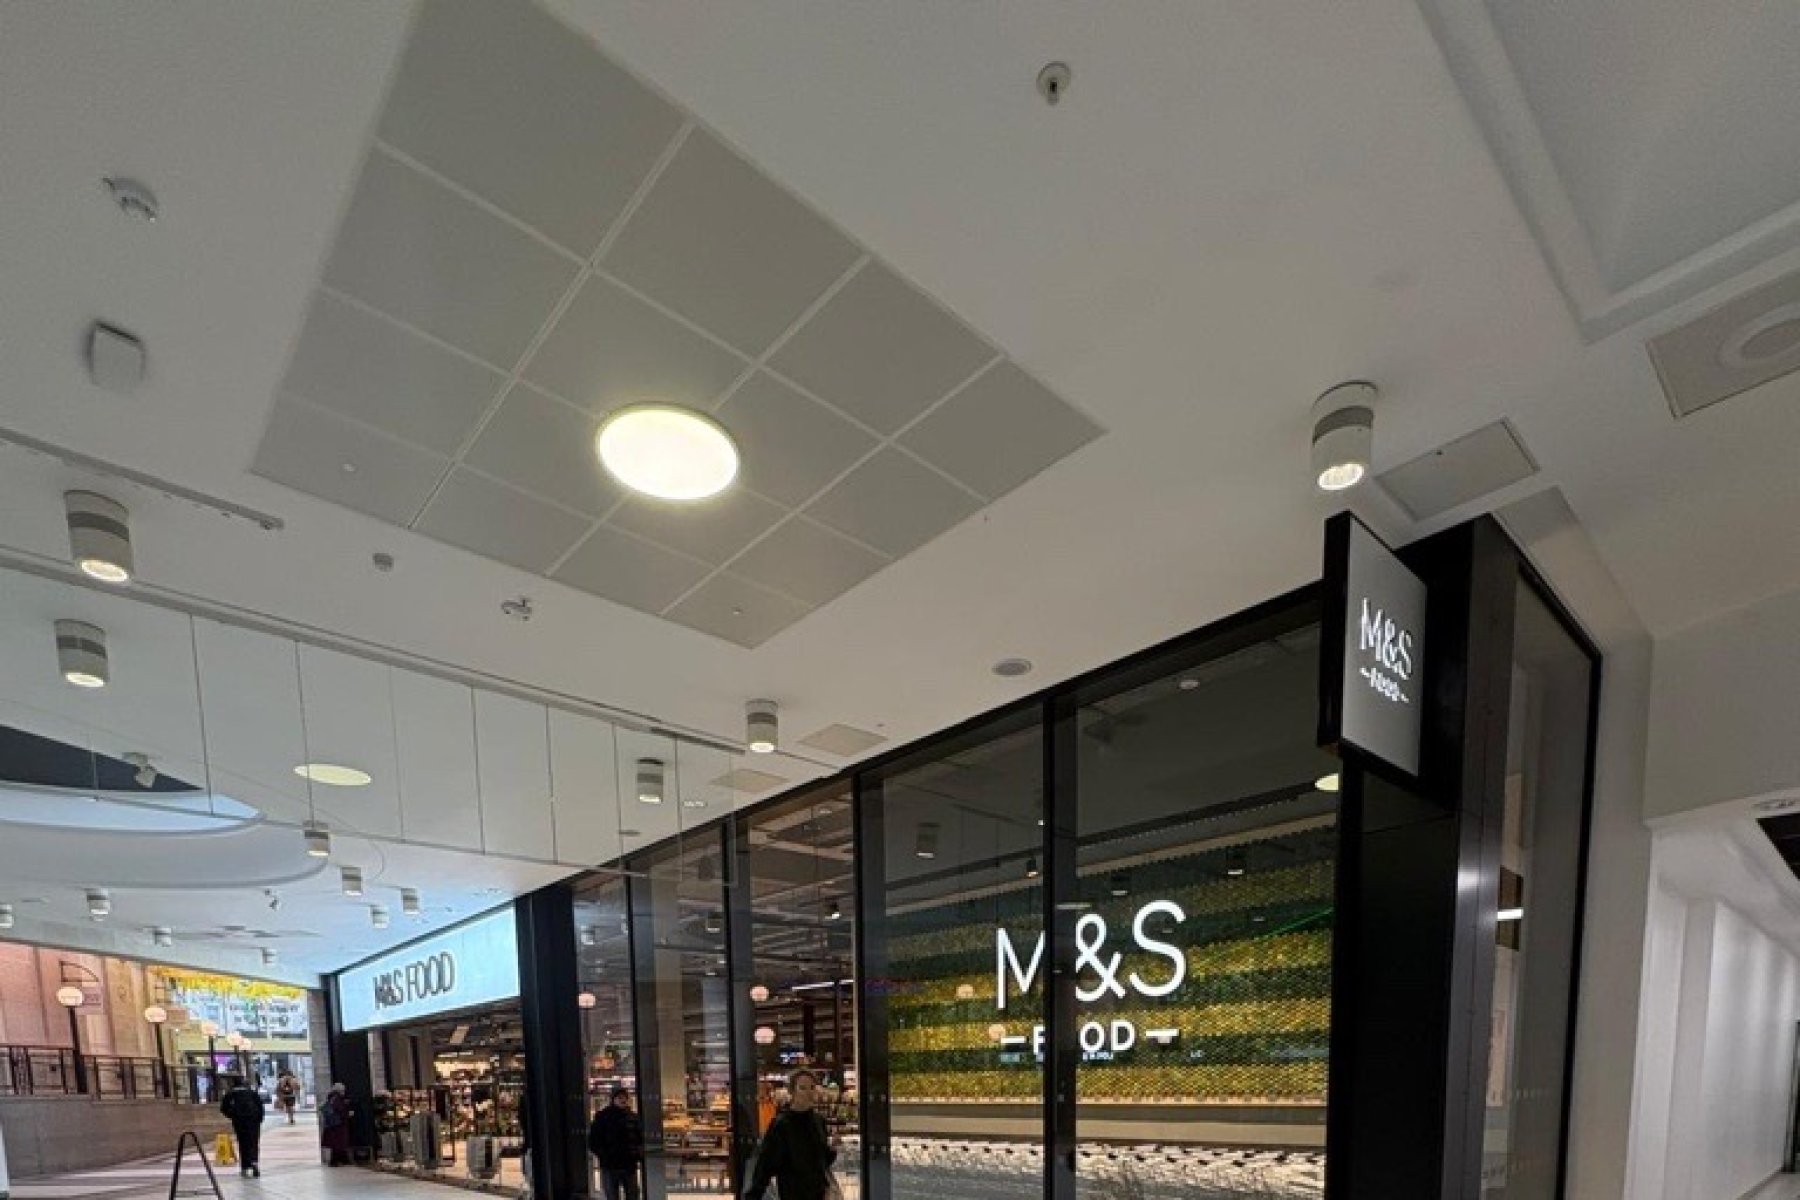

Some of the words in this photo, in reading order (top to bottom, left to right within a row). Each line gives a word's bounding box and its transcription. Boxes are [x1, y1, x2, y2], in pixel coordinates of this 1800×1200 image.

[1359, 597, 1412, 681] M&S
[405, 951, 456, 1002] FOOD
[996, 900, 1187, 1009] M&S
[1032, 1020, 1136, 1055] FOD
